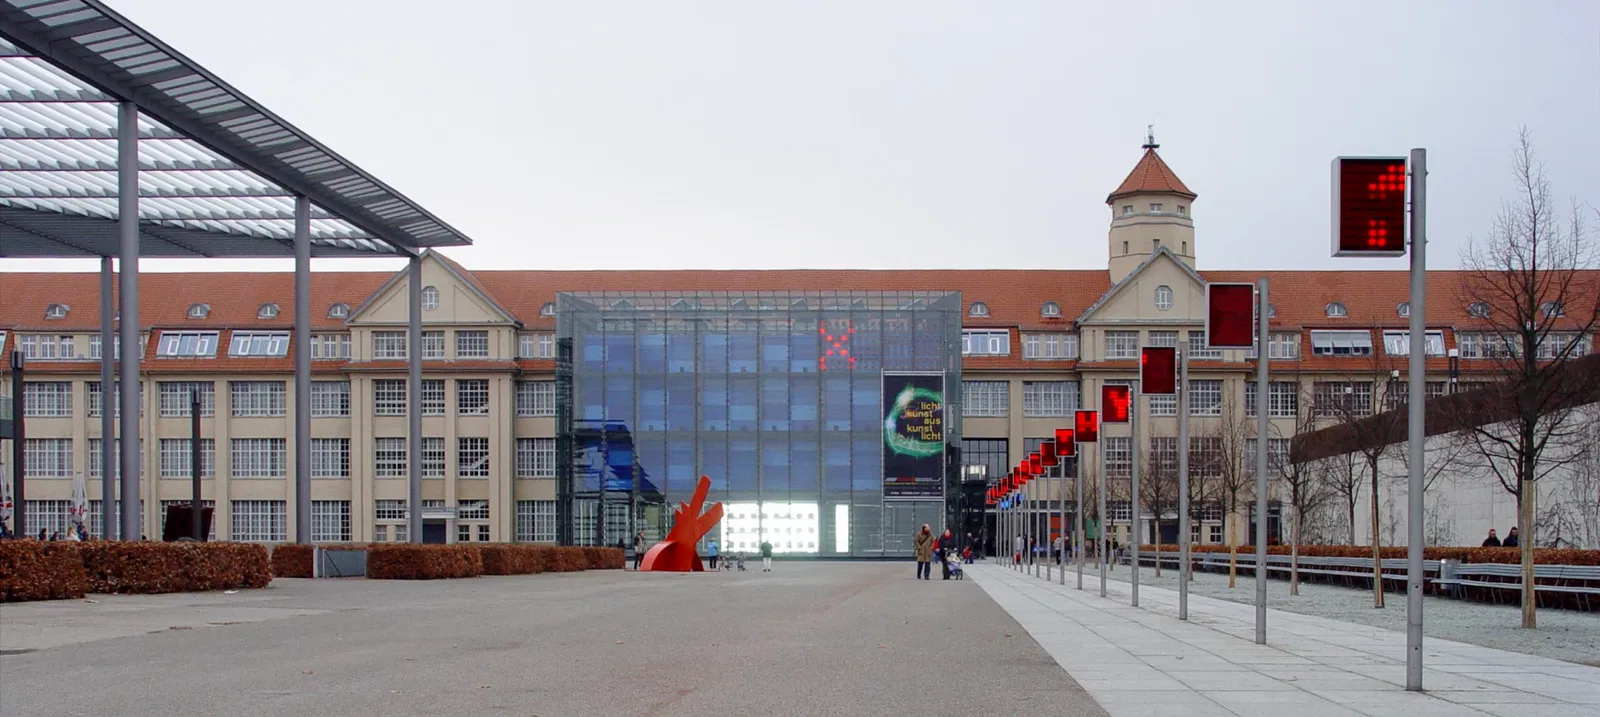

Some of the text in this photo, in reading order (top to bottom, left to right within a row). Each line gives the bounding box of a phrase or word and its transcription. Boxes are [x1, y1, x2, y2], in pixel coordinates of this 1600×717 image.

[921, 402, 941, 410] licht
[906, 409, 932, 417] kunst
[907, 424, 932, 432] kunst
[921, 432, 941, 440] licht
